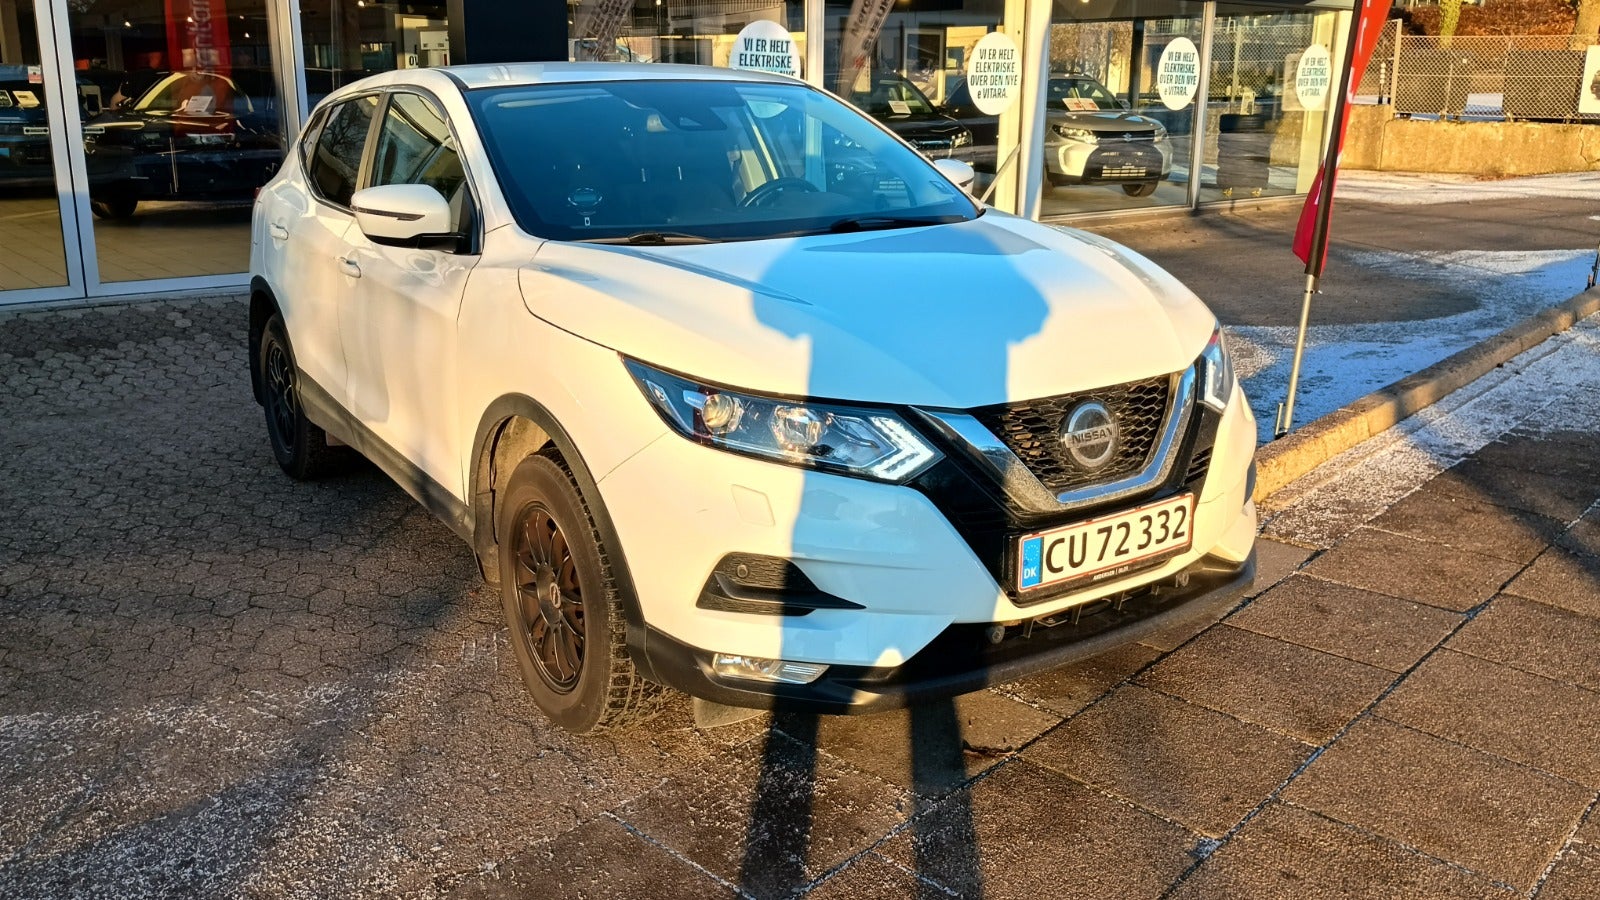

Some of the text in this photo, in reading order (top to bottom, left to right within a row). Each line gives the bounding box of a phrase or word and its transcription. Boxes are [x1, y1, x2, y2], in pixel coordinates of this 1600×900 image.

[744, 38, 790, 53] VI ER HELT
[980, 49, 1014, 60] VI ER HELT
[1175, 52, 1181, 61] ER
[1183, 53, 1195, 62] HELT
[739, 53, 792, 68] ELEKTRISKE
[975, 62, 1015, 73] ELEKTRISKE
[1164, 63, 1195, 74] ELEKTRISKE
[970, 75, 1018, 86] OVER DEN NYE
[1160, 75, 1197, 85] OVER DEN NYE
[1072, 427, 1113, 444] NISSAN
[1045, 505, 1187, 573] CU 72 332
[1023, 566, 1037, 580] DK
